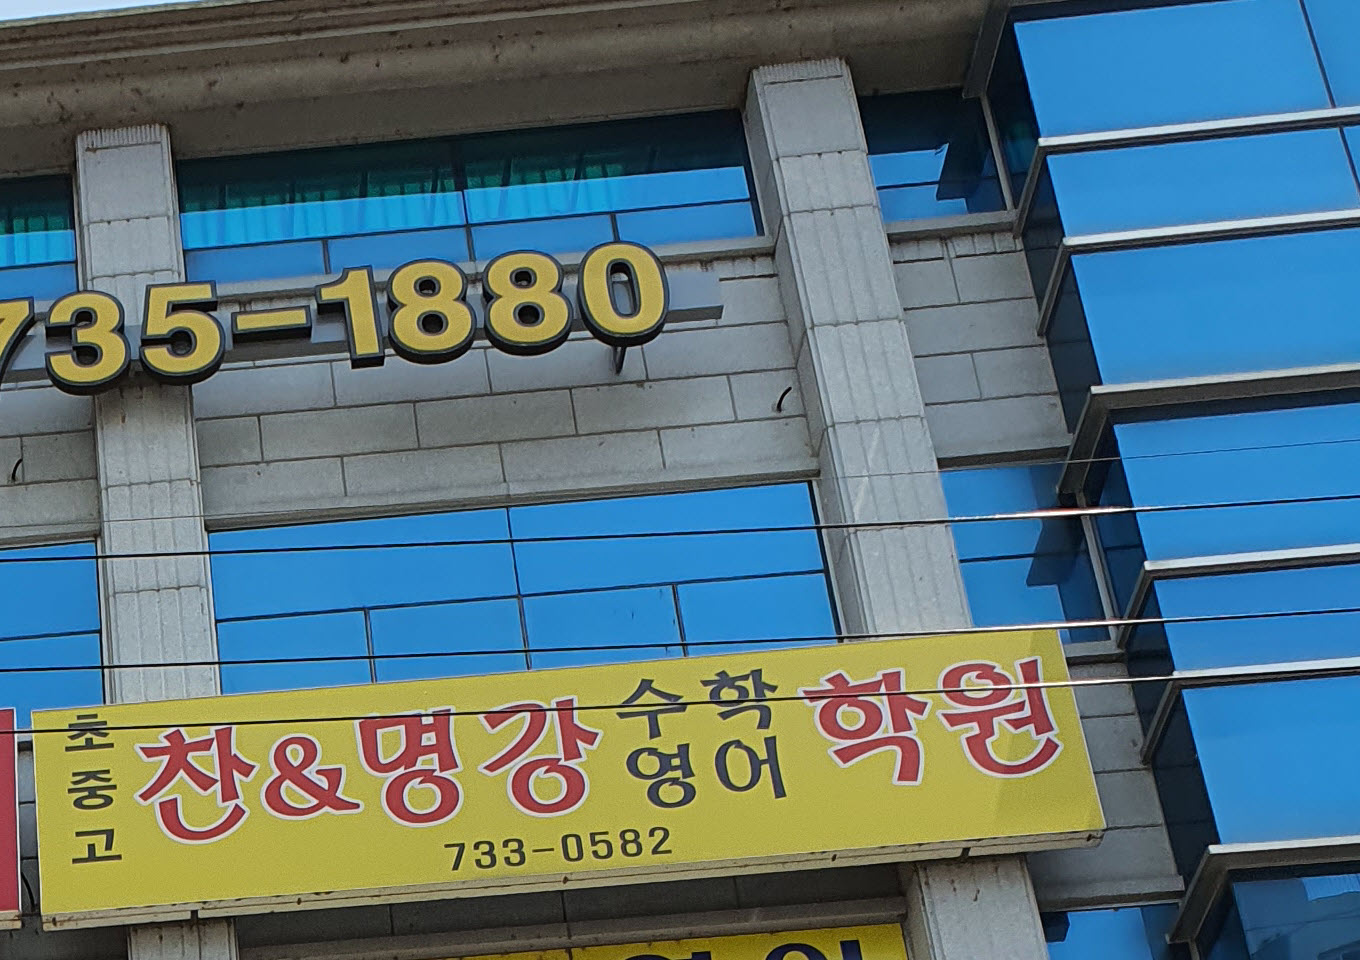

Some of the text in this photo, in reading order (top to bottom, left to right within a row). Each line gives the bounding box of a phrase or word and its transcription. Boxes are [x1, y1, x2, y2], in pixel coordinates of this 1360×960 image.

[616, 668, 779, 740] 수학
[798, 656, 1063, 786] 학원
[626, 736, 787, 808] 영어
[444, 826, 672, 871] 733-0582
